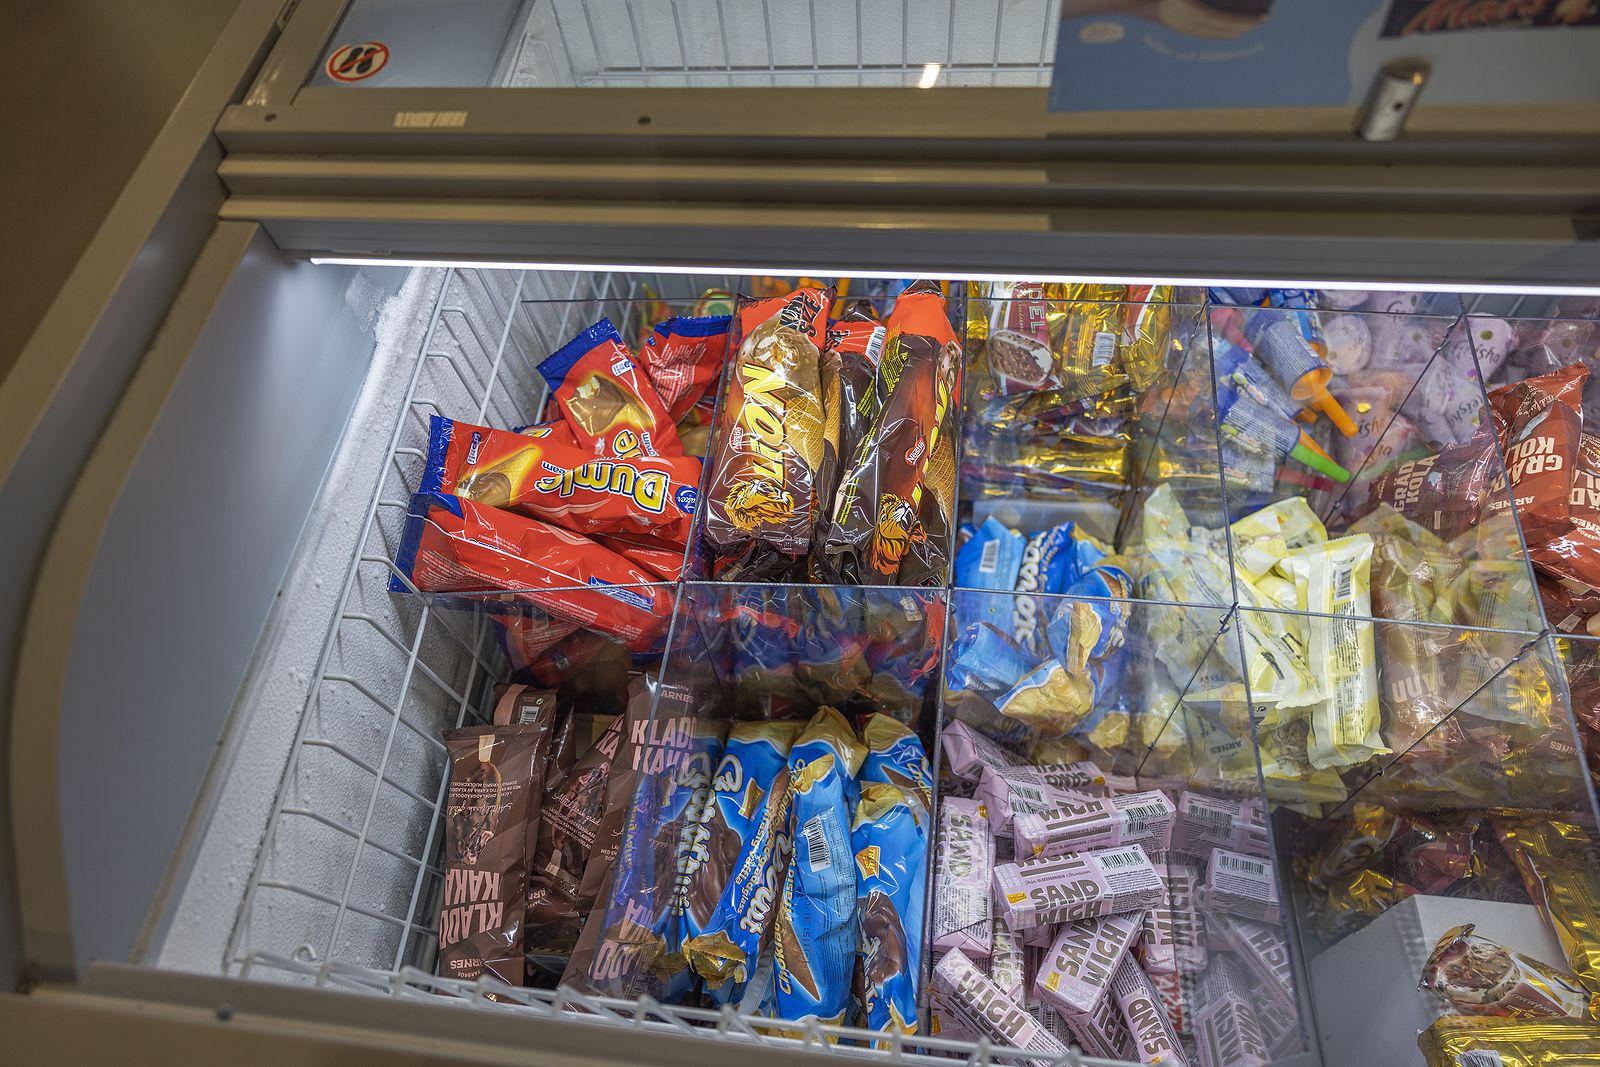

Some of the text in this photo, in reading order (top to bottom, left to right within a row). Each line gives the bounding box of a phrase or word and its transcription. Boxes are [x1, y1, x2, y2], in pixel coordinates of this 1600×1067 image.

[799, 292, 823, 338] SIZE
[1028, 286, 1045, 334] DEL
[676, 496, 697, 506] azer
[1394, 461, 1415, 513] GRÄD
[1405, 455, 1439, 504] KOLA
[948, 814, 973, 878] SAND
[445, 867, 500, 906] KAKA
[1030, 879, 1100, 911] SAND
[1035, 901, 1103, 926] WICH
[1055, 917, 1100, 978] SAND
[1081, 923, 1129, 990] WICH
[957, 970, 1027, 1040] WICH
[1127, 998, 1171, 1056] SAND
